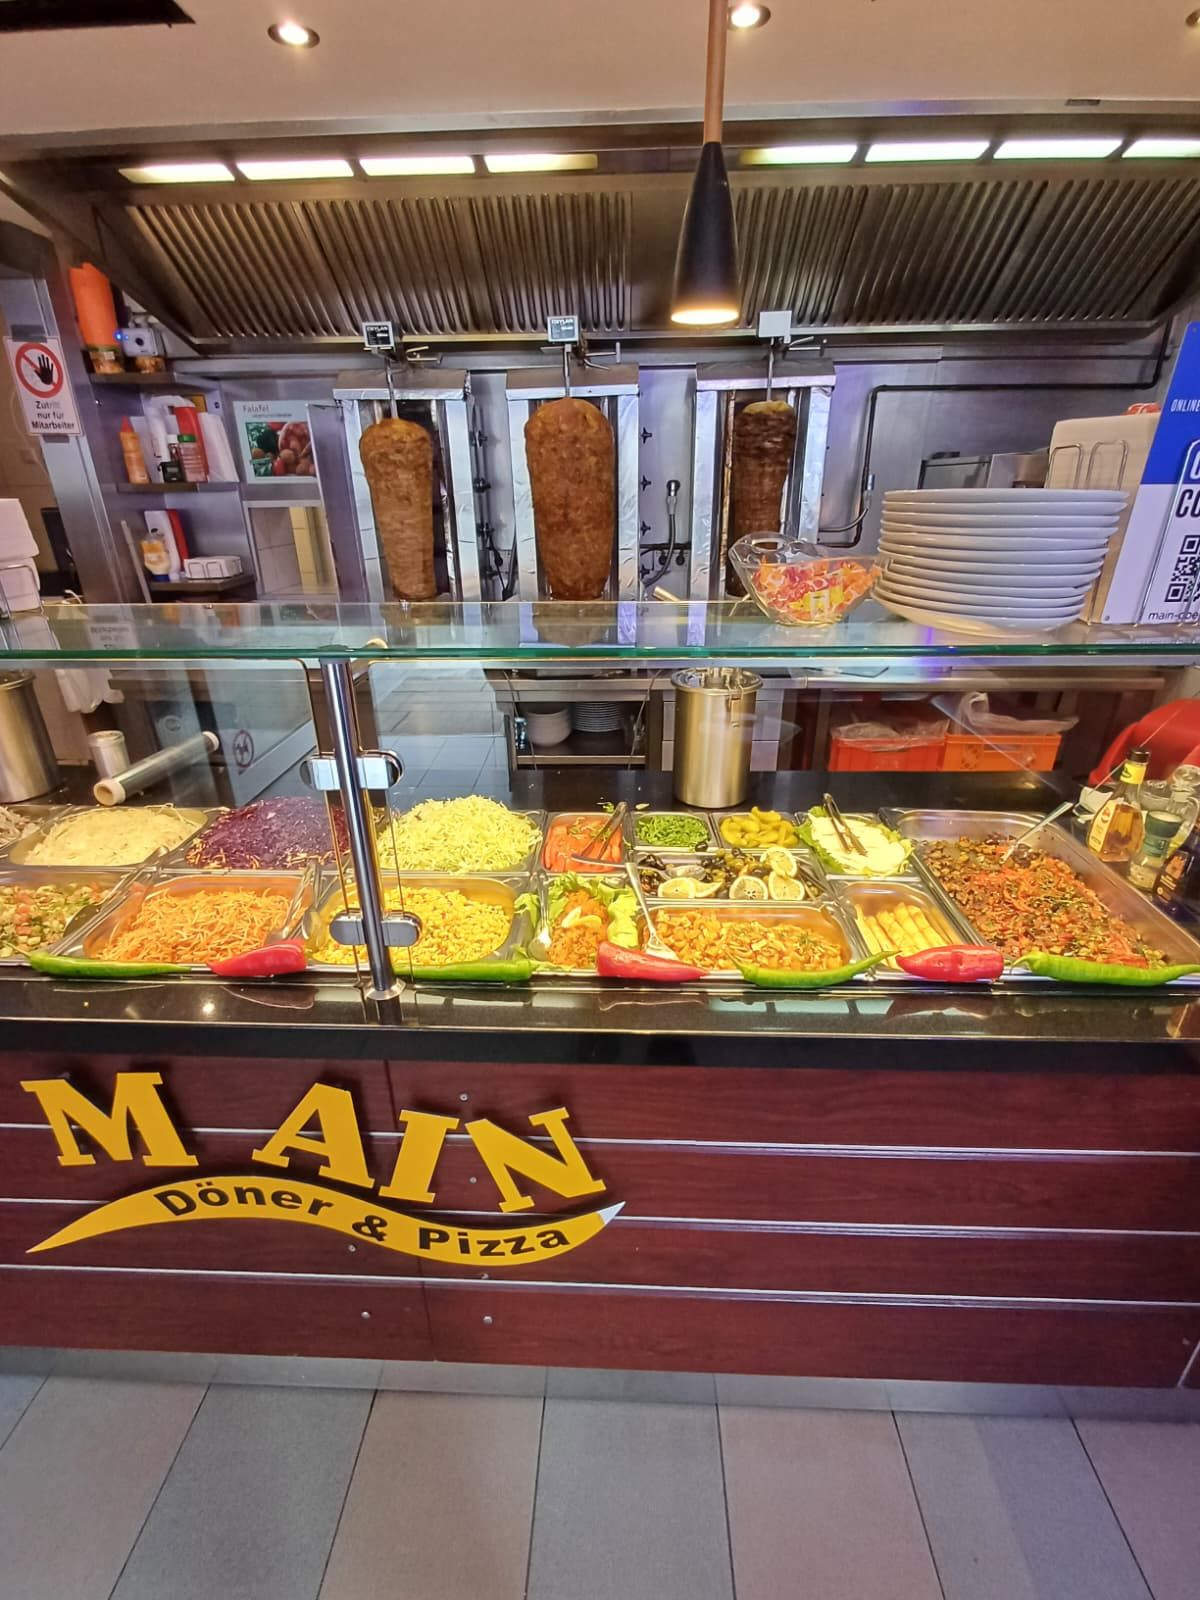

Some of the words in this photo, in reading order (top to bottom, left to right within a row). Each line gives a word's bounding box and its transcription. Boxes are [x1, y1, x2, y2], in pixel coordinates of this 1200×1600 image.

[242, 404, 270, 413] Falafel
[53, 411, 64, 419] für
[31, 421, 75, 430] Mitarbeiter
[20, 1071, 606, 1213] MAIN
[154, 1182, 334, 1217] Döner
[352, 1215, 388, 1242] &
[419, 1227, 570, 1258] Pizza
